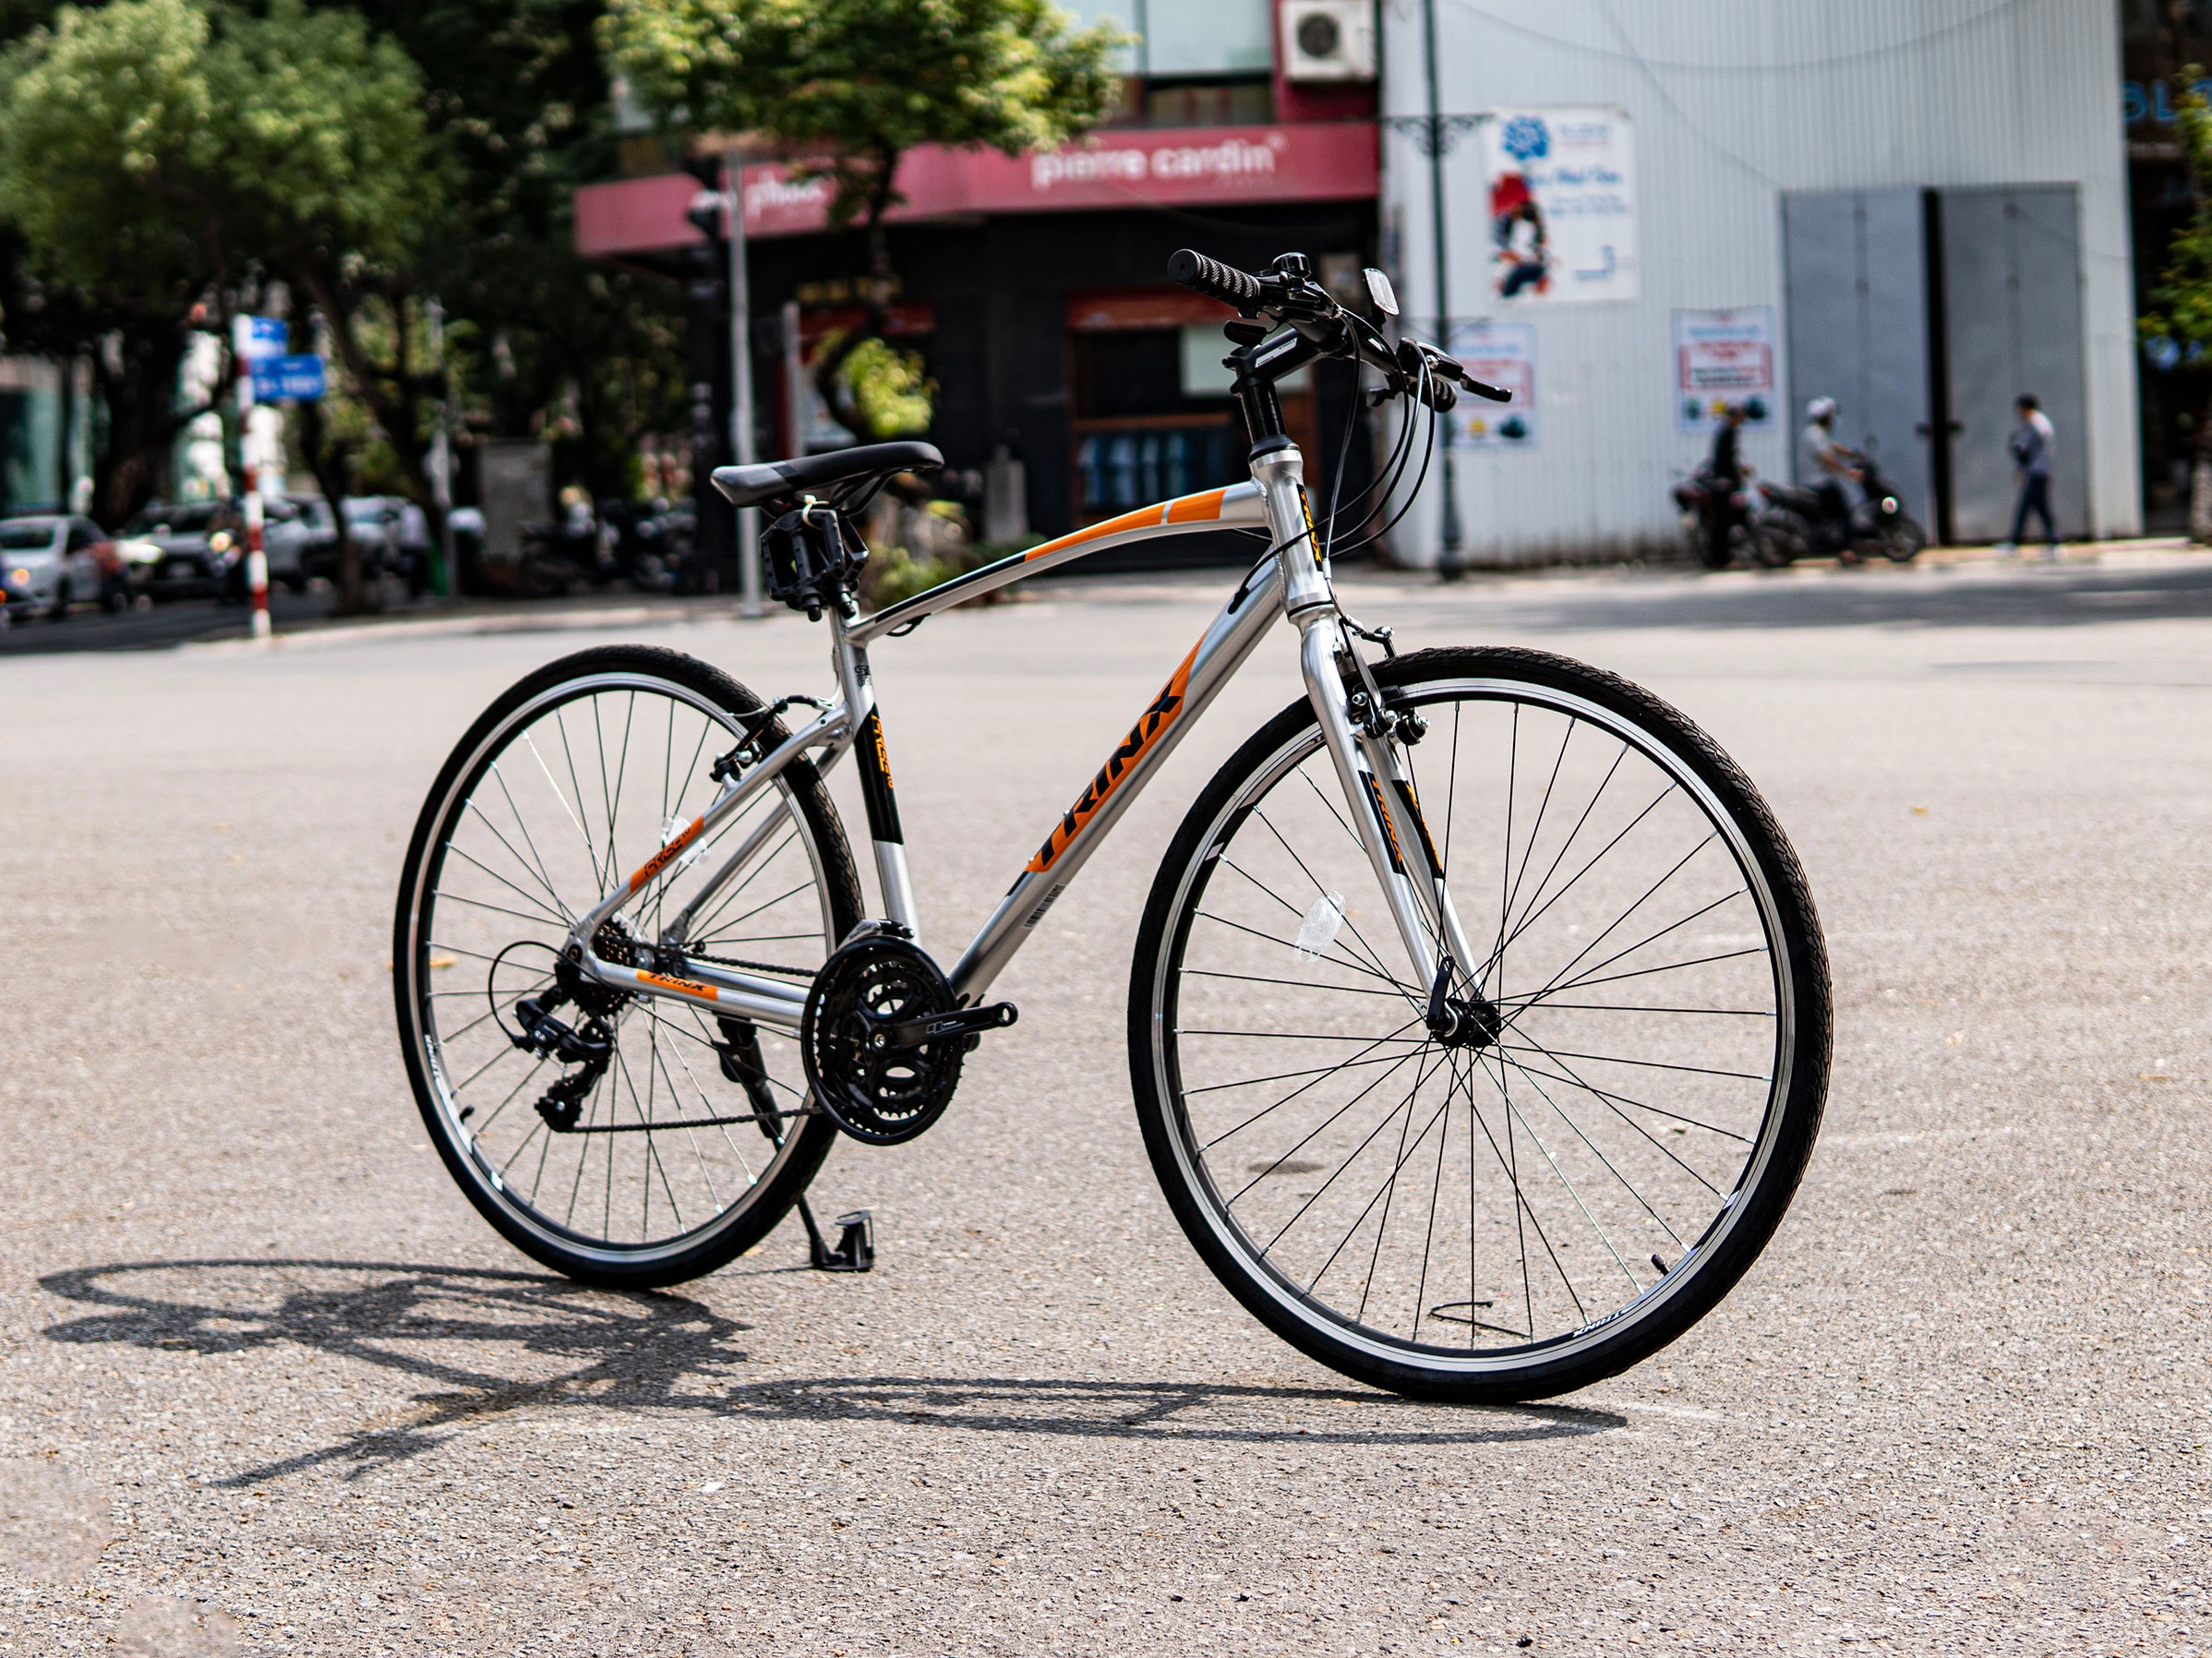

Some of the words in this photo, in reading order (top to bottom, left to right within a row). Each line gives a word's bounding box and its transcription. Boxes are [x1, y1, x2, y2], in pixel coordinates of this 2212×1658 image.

[1031, 149, 1148, 189] pierre
[1151, 138, 1276, 179] cardin
[1040, 678, 1182, 867] TRINX
[650, 973, 705, 991] TRINX
[1572, 1310, 1621, 1338] TRINX
